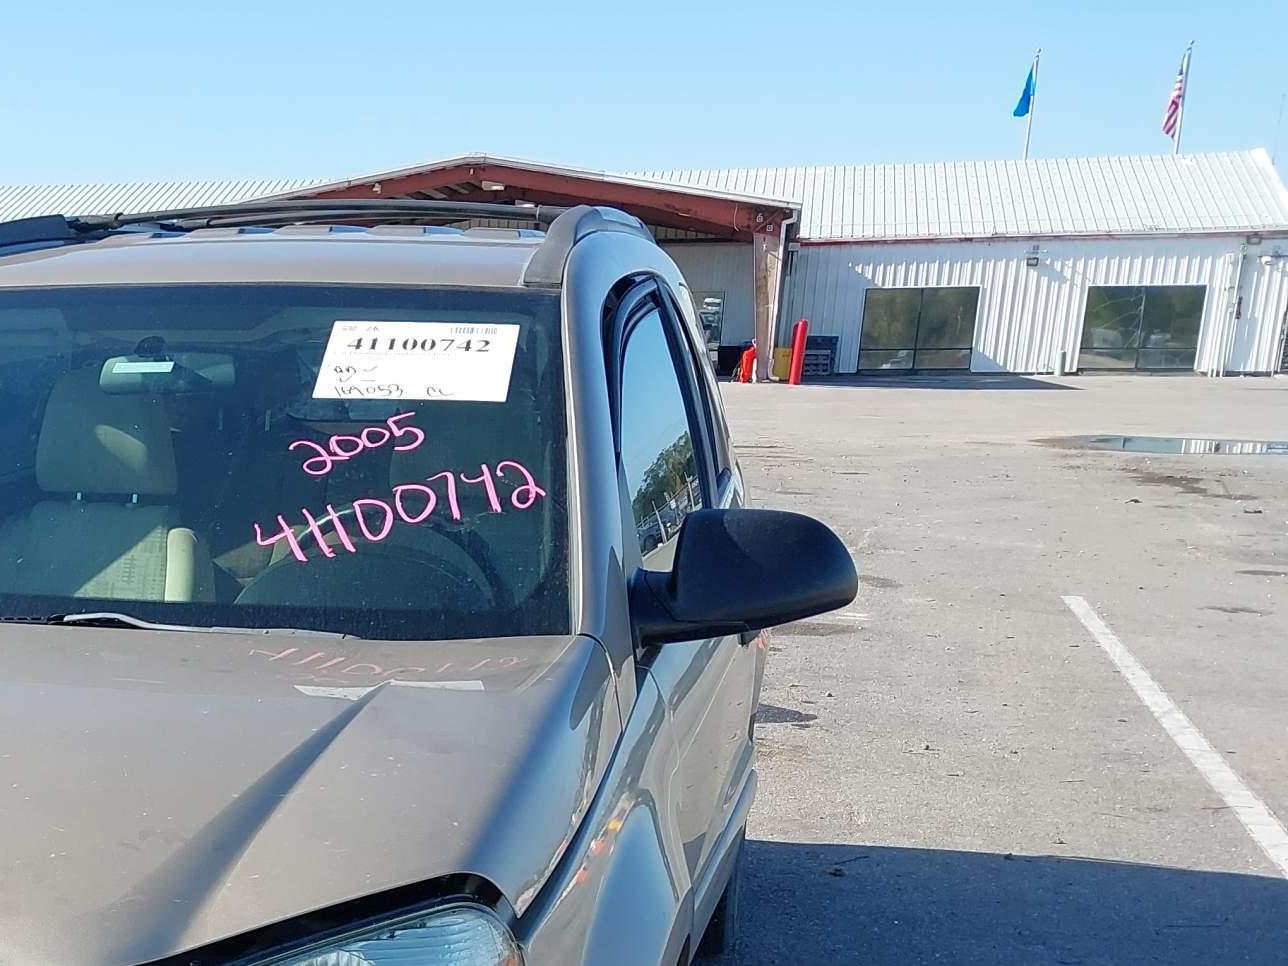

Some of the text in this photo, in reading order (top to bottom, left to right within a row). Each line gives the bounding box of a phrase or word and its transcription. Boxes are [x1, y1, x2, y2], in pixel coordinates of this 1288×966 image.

[346, 337, 491, 352] 41100742
[288, 411, 425, 476] 2005
[253, 460, 547, 562] 41100742
